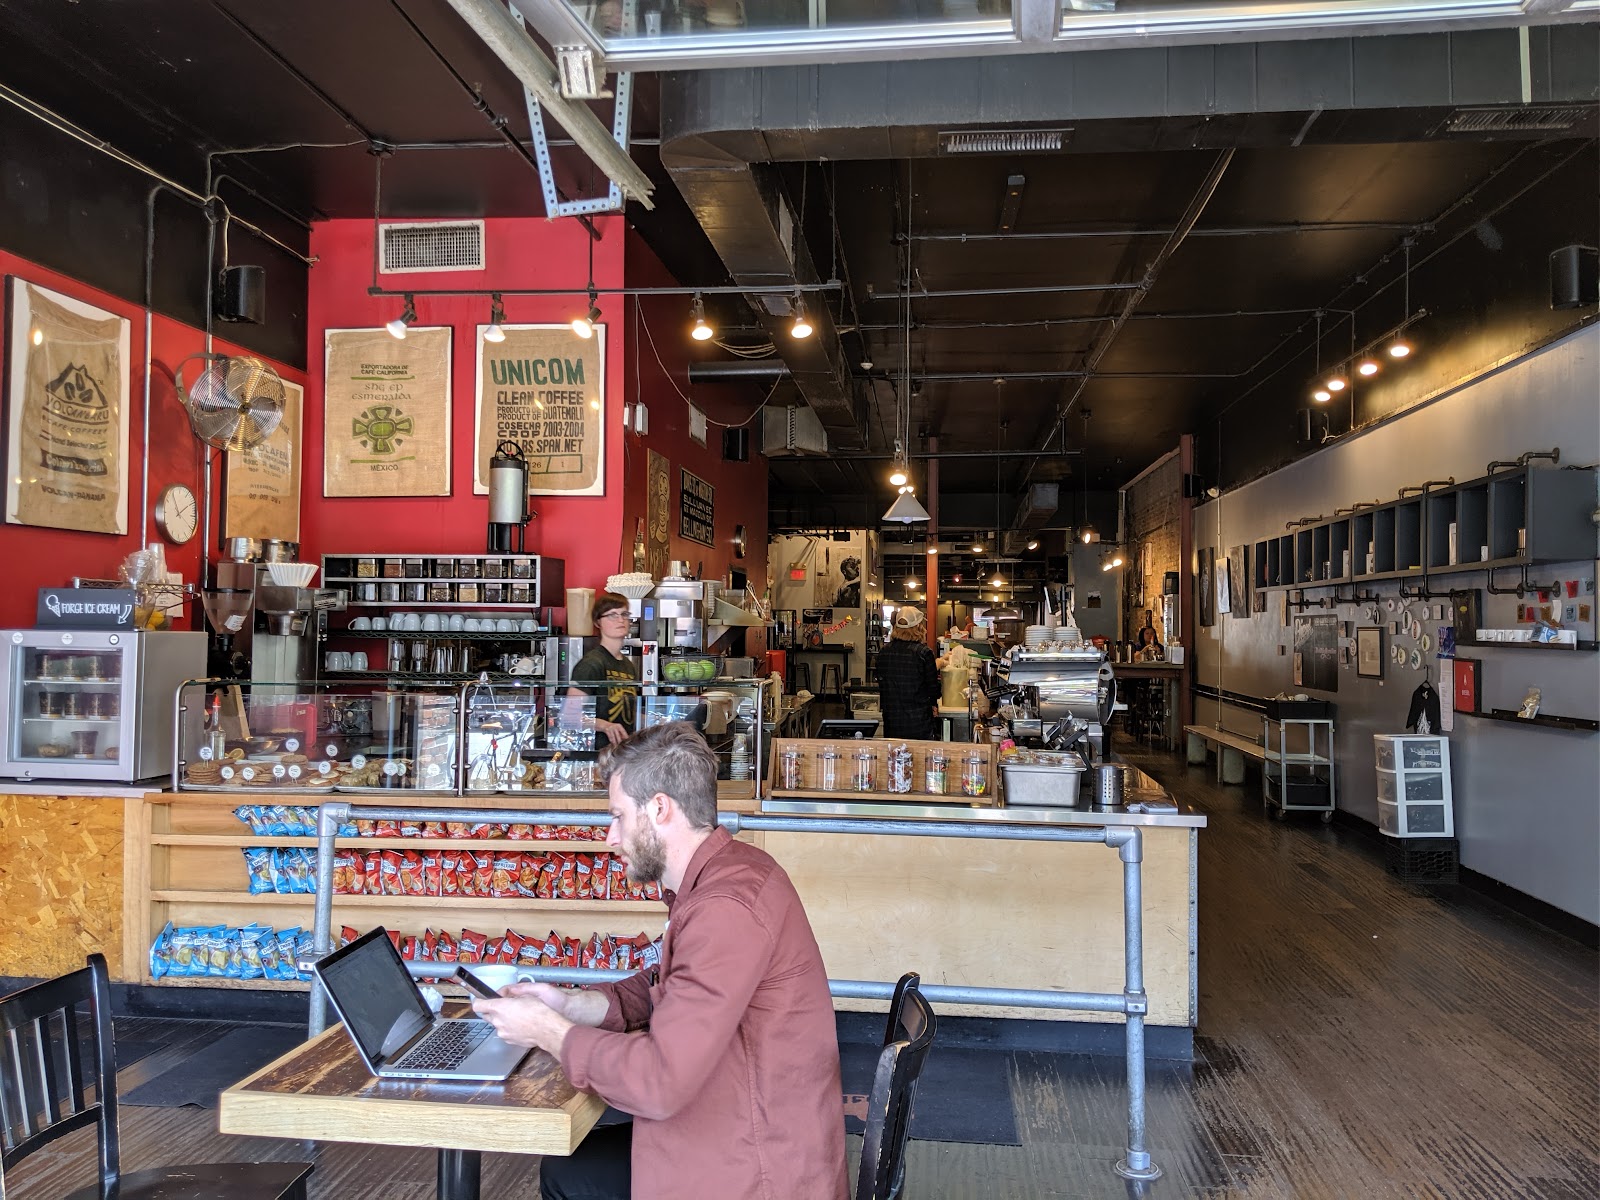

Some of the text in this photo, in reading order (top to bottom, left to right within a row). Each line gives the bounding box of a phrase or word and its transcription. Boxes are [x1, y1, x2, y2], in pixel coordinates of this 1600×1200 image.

[490, 358, 585, 385] UNICOM
[497, 390, 535, 405] CLEAN
[497, 406, 530, 414] PRODUCTO
[543, 405, 584, 421] GUATEMALA
[497, 413, 541, 421] PRODUCT OF
[497, 421, 585, 438] COSECHA 2003-2004
[497, 430, 540, 438] CROP
[61, 603, 120, 614] FORGE ICE CREAM
